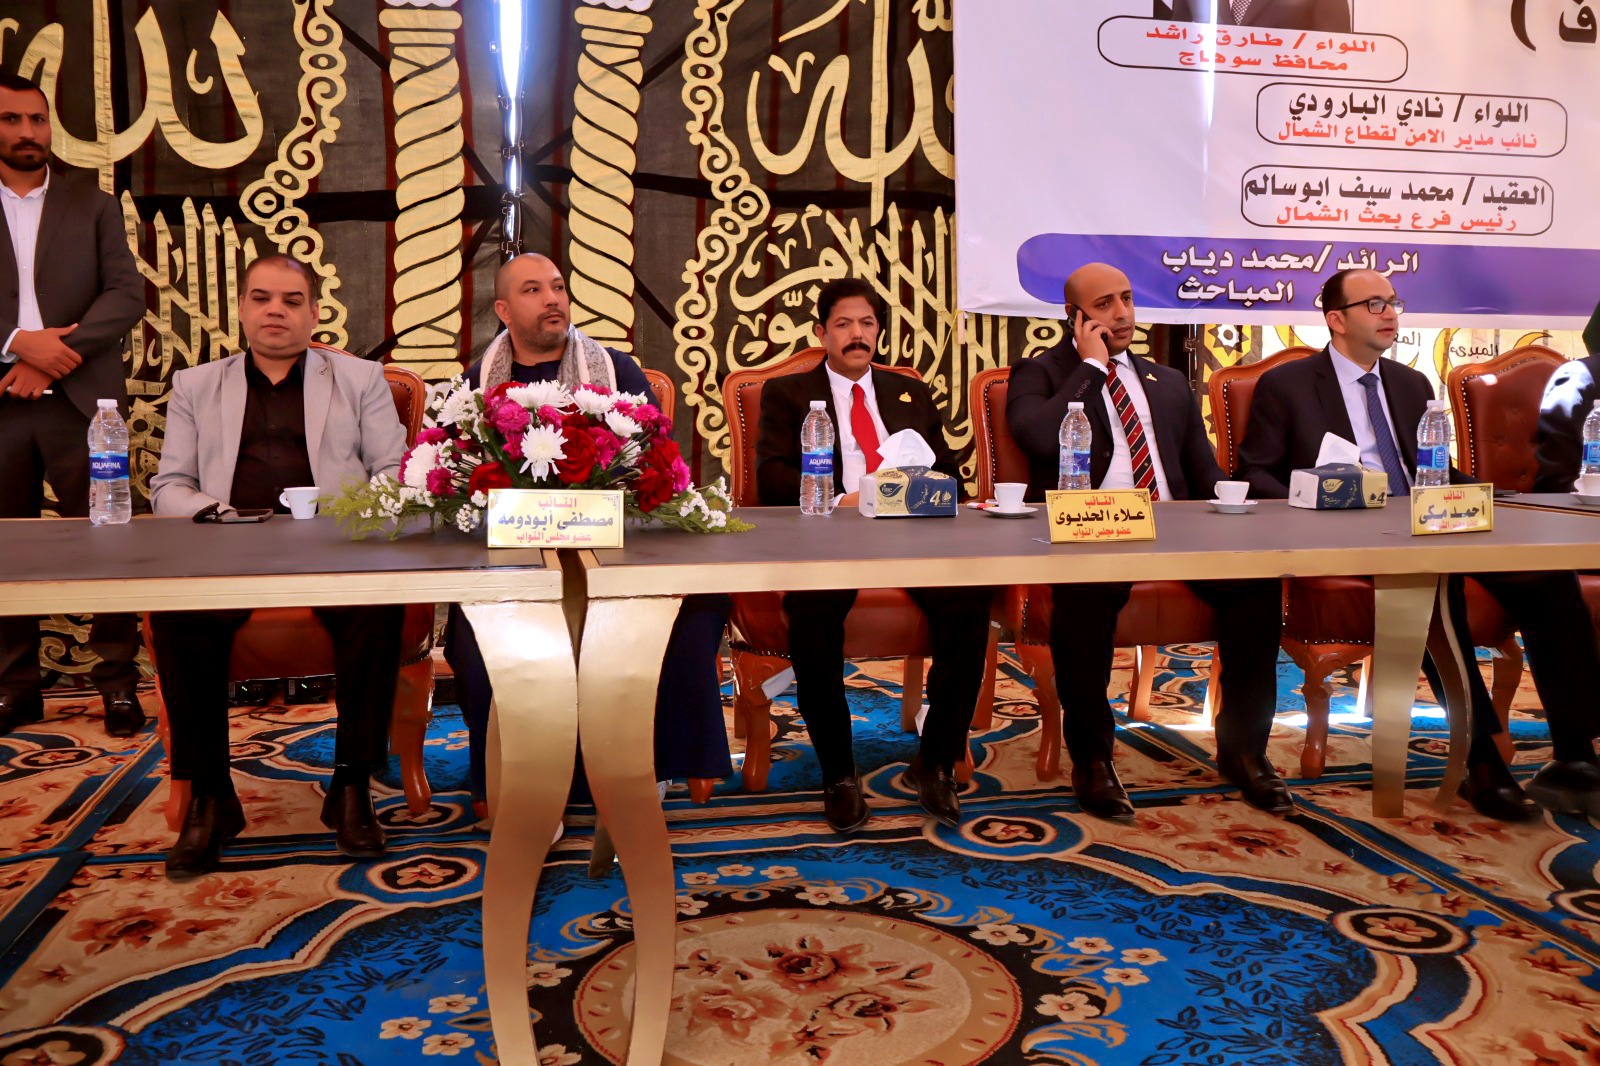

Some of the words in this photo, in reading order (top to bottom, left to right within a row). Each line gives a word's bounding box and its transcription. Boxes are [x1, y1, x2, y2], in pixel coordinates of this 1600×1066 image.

[1146, 24, 1204, 45] راشد
[1216, 29, 1283, 48] طارق
[1316, 38, 1376, 54] اللواء
[1178, 49, 1262, 68] سوهاج
[1273, 54, 1348, 71] محافظ
[1289, 91, 1386, 121] البارودي
[1396, 96, 1444, 126] نادي
[1474, 101, 1529, 128] اللواء
[1278, 120, 1338, 140] الشمال
[1344, 124, 1397, 144] لقطاع
[1405, 128, 1445, 146] الامن
[1453, 133, 1494, 151] مدير
[1501, 132, 1537, 151] نائب
[1339, 176, 1392, 206] سيف
[1401, 181, 1455, 202] محمد
[1482, 181, 1546, 212] العقيد
[1276, 205, 1348, 225] الشمال
[1358, 206, 1401, 230] بحث
[1411, 209, 1451, 230] فرع
[1460, 211, 1517, 232] رئيس
[1162, 245, 1234, 275] دياب
[1177, 274, 1294, 308] المباحث
[92, 462, 122, 470] AQUAFINA
[538, 496, 577, 510] النائب
[930, 490, 942, 506] 4
[1085, 496, 1115, 509] النائب
[1377, 491, 1386, 503] 4
[1443, 490, 1465, 503] النائب
[1113, 508, 1145, 522] علاء
[1450, 500, 1485, 518] أحمد
[557, 511, 614, 530] مصطفى
[517, 531, 544, 543] النواب
[1072, 527, 1094, 538] النواب
[1116, 527, 1132, 537] عضو
